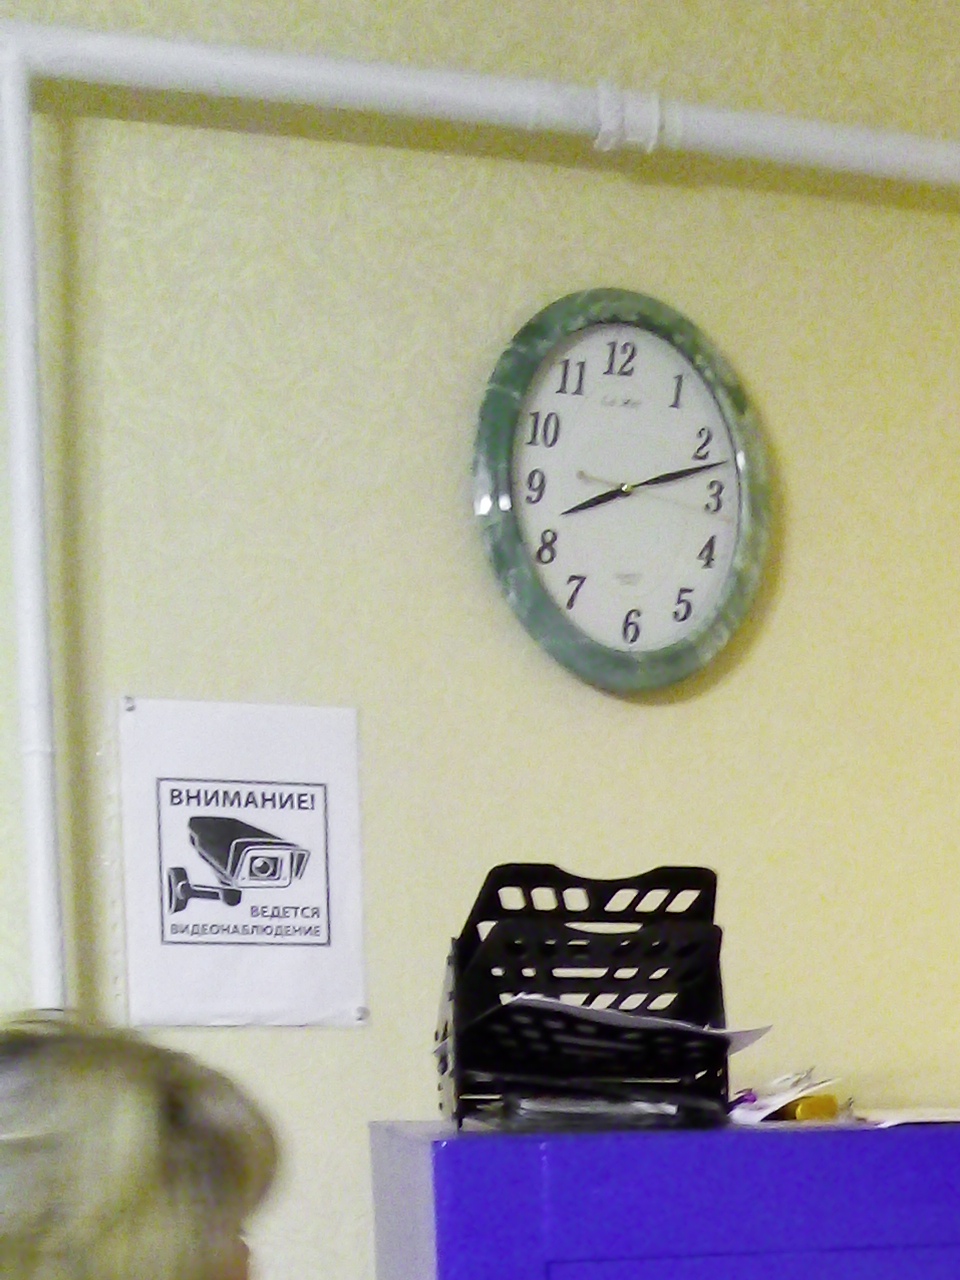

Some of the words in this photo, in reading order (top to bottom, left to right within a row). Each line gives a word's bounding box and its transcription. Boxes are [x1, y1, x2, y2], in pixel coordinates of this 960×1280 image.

[555, 358, 587, 396] 11
[603, 341, 637, 377] 12
[668, 374, 685, 409] 1
[526, 411, 561, 448] 10
[692, 426, 713, 461] 2
[525, 468, 547, 504] 9
[704, 480, 725, 514] 3
[535, 529, 558, 565] 8
[697, 534, 717, 569] 4
[566, 574, 587, 611] 7
[672, 587, 694, 623] 5
[621, 608, 642, 645] 6
[170, 788, 316, 811] ВНИМАНИЕ!
[251, 905, 321, 919] ВЕДЕТСЯ
[170, 923, 321, 938] ВИДЕОНАБЛЮДЕНИЕ
